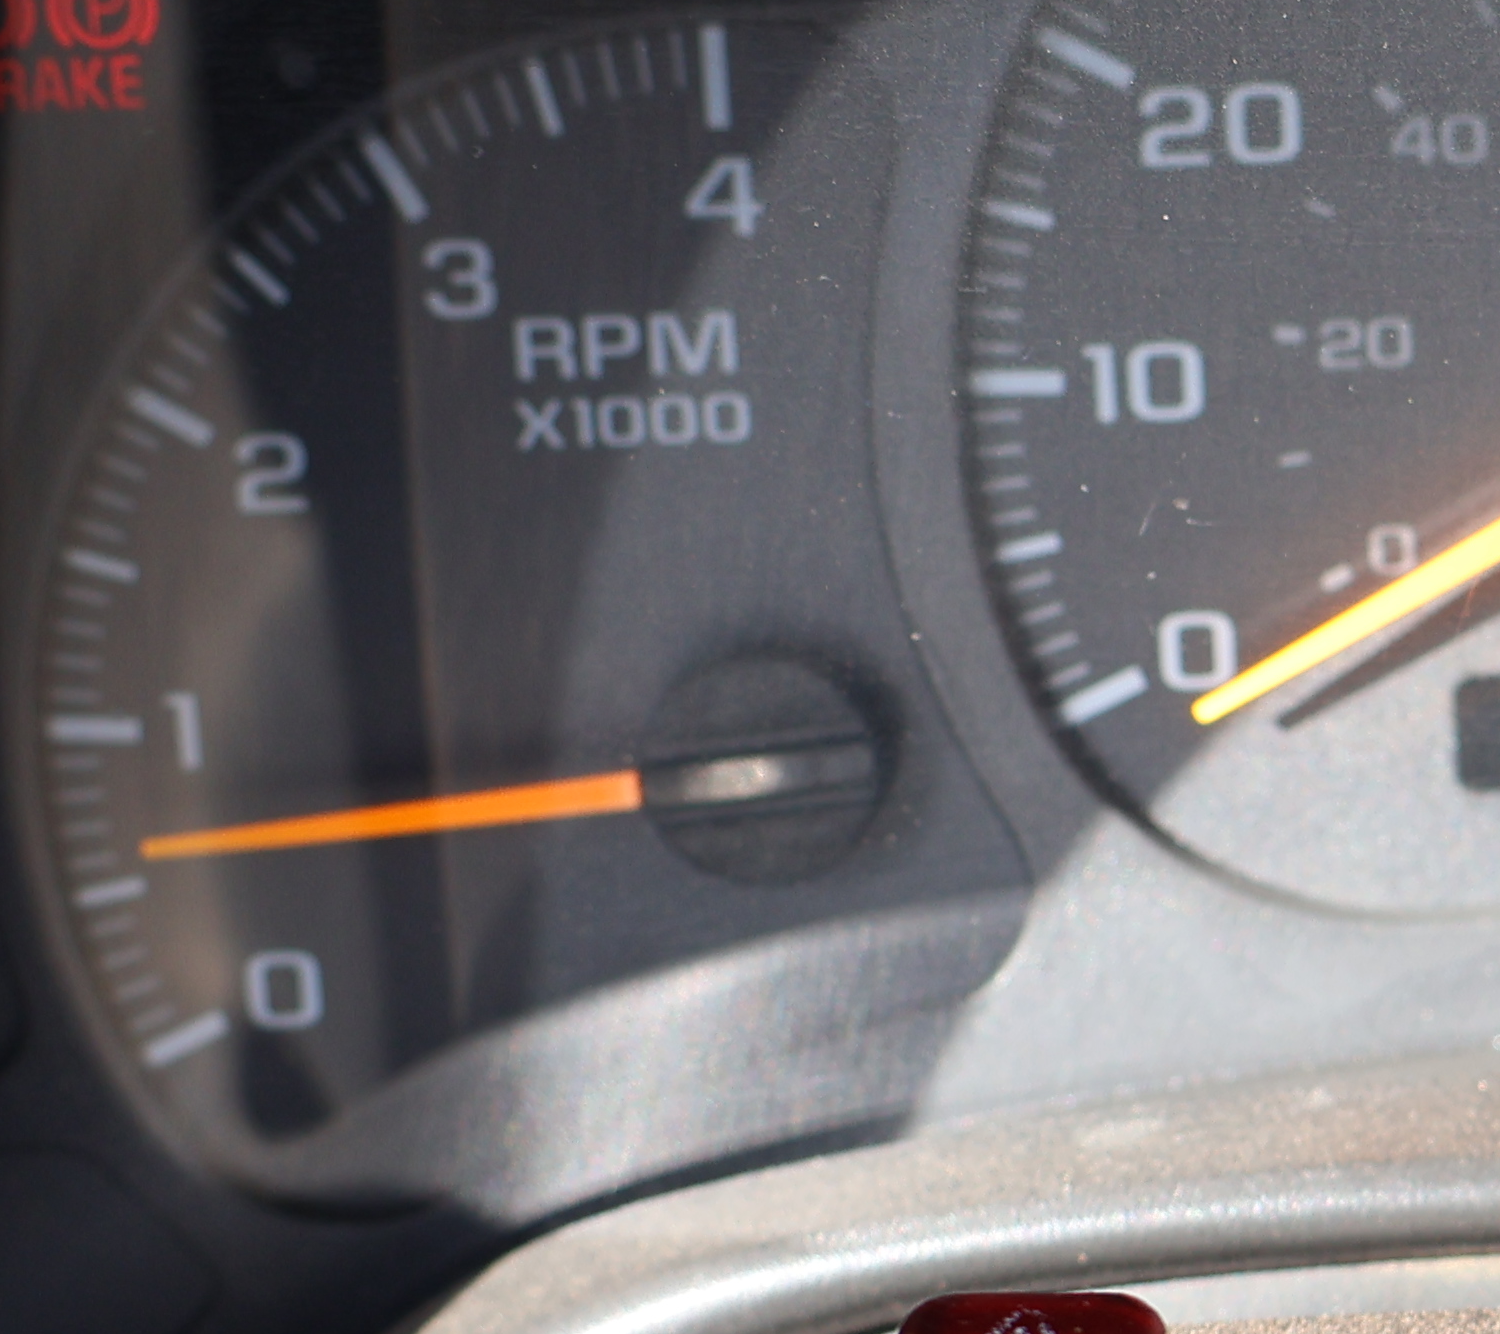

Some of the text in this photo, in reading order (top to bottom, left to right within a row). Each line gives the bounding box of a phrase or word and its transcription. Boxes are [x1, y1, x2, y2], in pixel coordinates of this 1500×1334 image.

[1138, 87, 1300, 167] 20
[1390, 114, 1488, 165] 40
[685, 157, 763, 236] 4
[424, 240, 497, 319] 3
[513, 311, 738, 381] RPM
[1083, 342, 1205, 422] 10
[1318, 319, 1413, 369] 20
[514, 395, 752, 450] X1000
[236, 434, 307, 513] 2
[1367, 523, 1418, 575] 0
[1158, 610, 1238, 692] 0
[165, 691, 202, 771] 1
[246, 951, 321, 1028] 0
